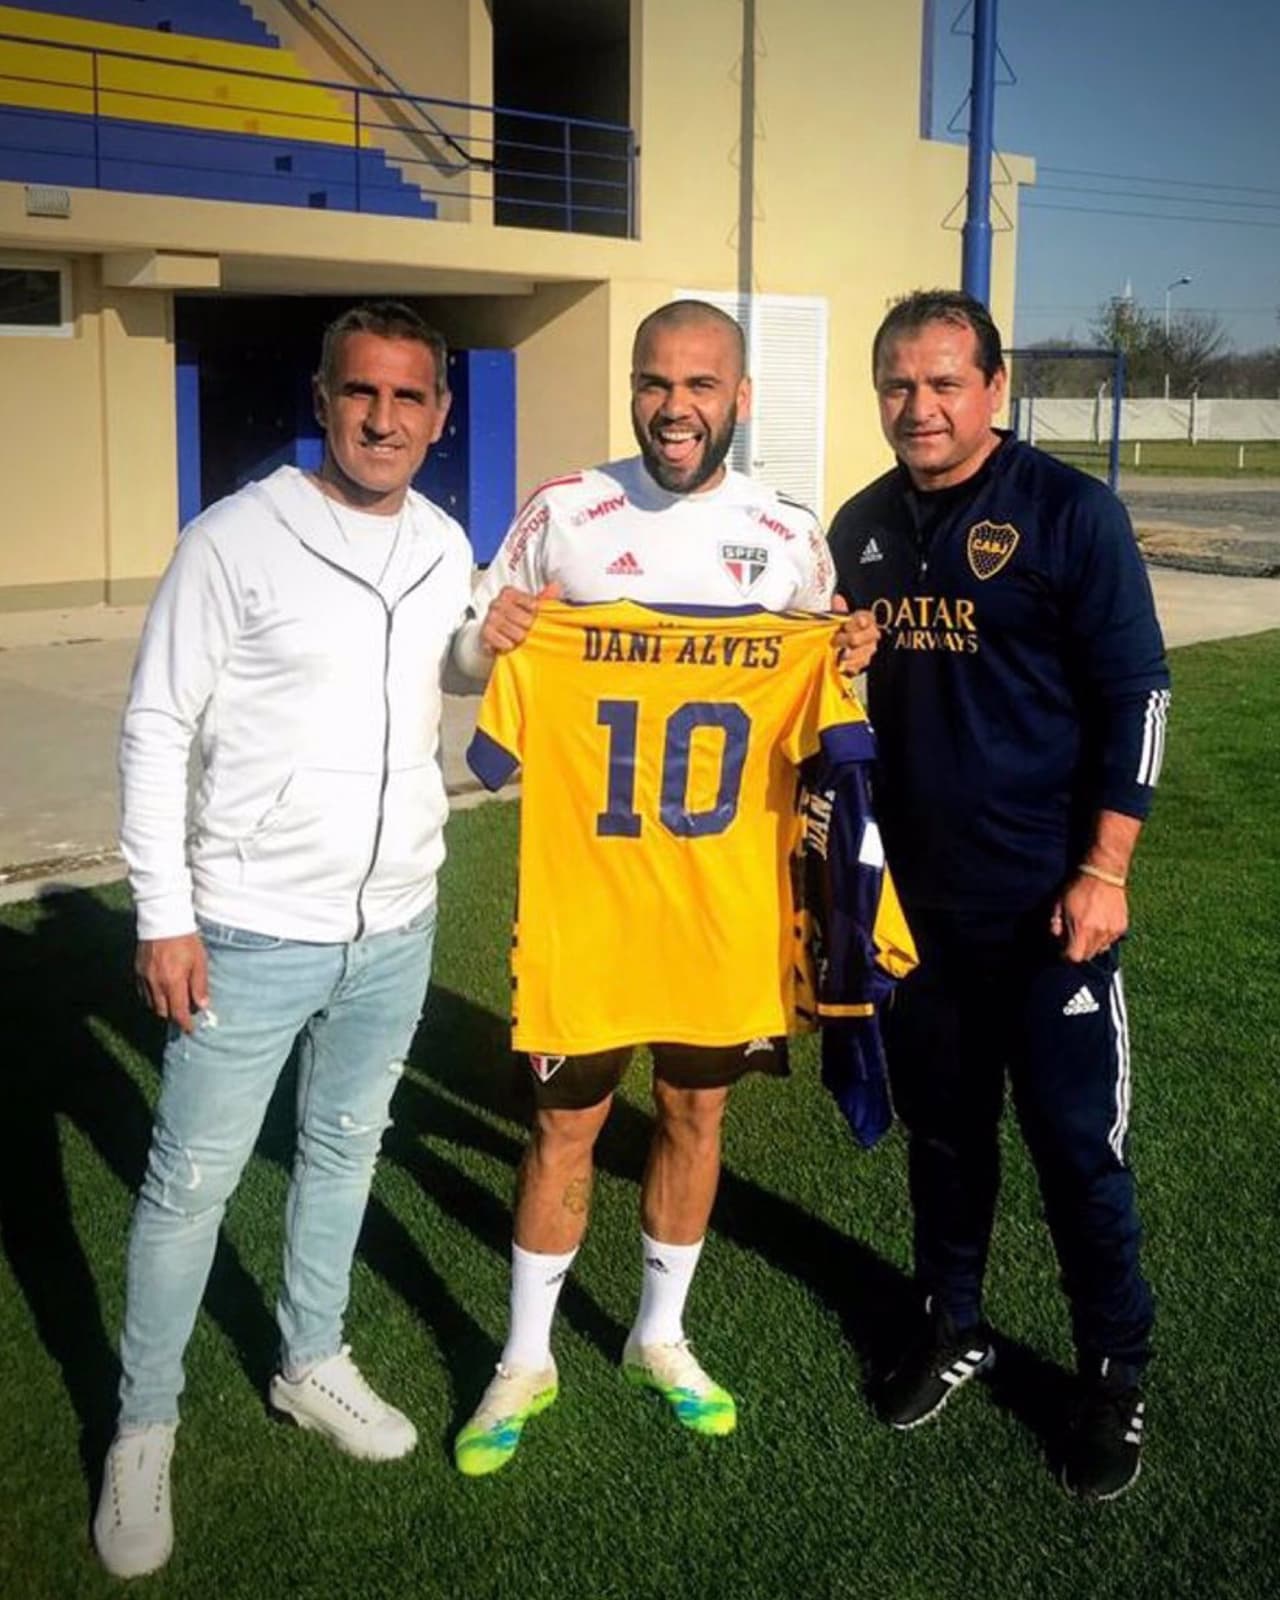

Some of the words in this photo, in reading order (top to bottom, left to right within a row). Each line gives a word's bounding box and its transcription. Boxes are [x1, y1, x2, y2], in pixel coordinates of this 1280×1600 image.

[723, 545, 768, 563] SPFC
[871, 597, 977, 634] QATAR
[582, 626, 662, 663] DANI
[675, 634, 783, 669] ALVES
[894, 629, 979, 654] AIRWAYS
[596, 700, 753, 838] 10
